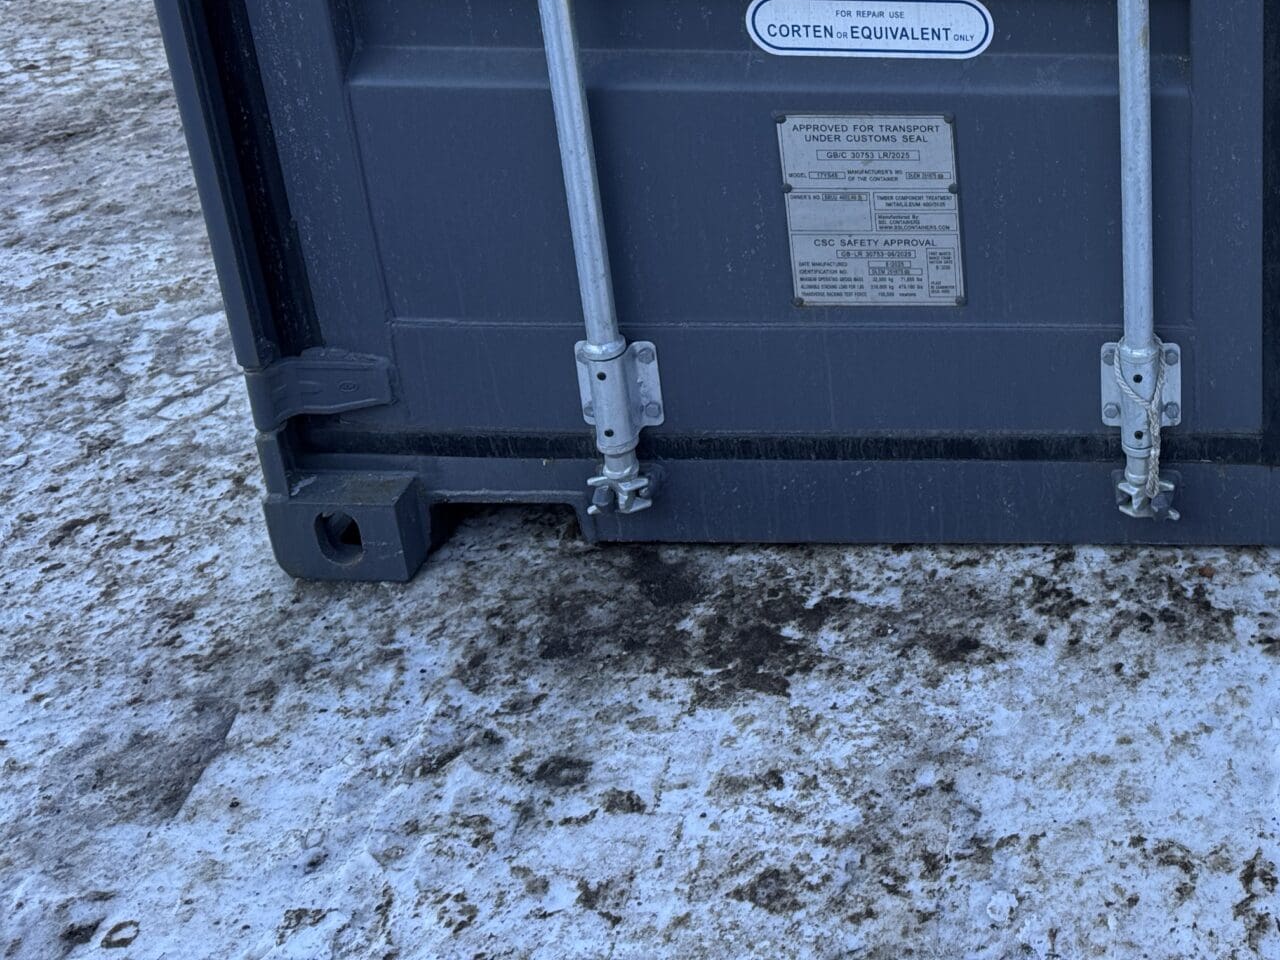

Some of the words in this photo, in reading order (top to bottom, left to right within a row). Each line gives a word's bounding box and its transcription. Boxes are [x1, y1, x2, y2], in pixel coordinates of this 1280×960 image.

[835, 9, 852, 18] FOR
[856, 9, 885, 19] REPAIR
[889, 10, 905, 19] USE
[767, 24, 835, 39] CORTEN
[836, 30, 848, 39] OR
[850, 25, 951, 41] EQUIVALENT
[953, 33, 975, 42] ONLY
[792, 124, 848, 133] APPROVED
[853, 124, 874, 133] FOR
[879, 124, 940, 133] TRANSPORT
[804, 134, 841, 143] UNDER
[846, 134, 897, 143] CUSTOMS
[902, 134, 929, 143] SEAL
[814, 239, 836, 247] CSC
[840, 239, 879, 247] SAFETY
[883, 239, 937, 247] APPROVAL
